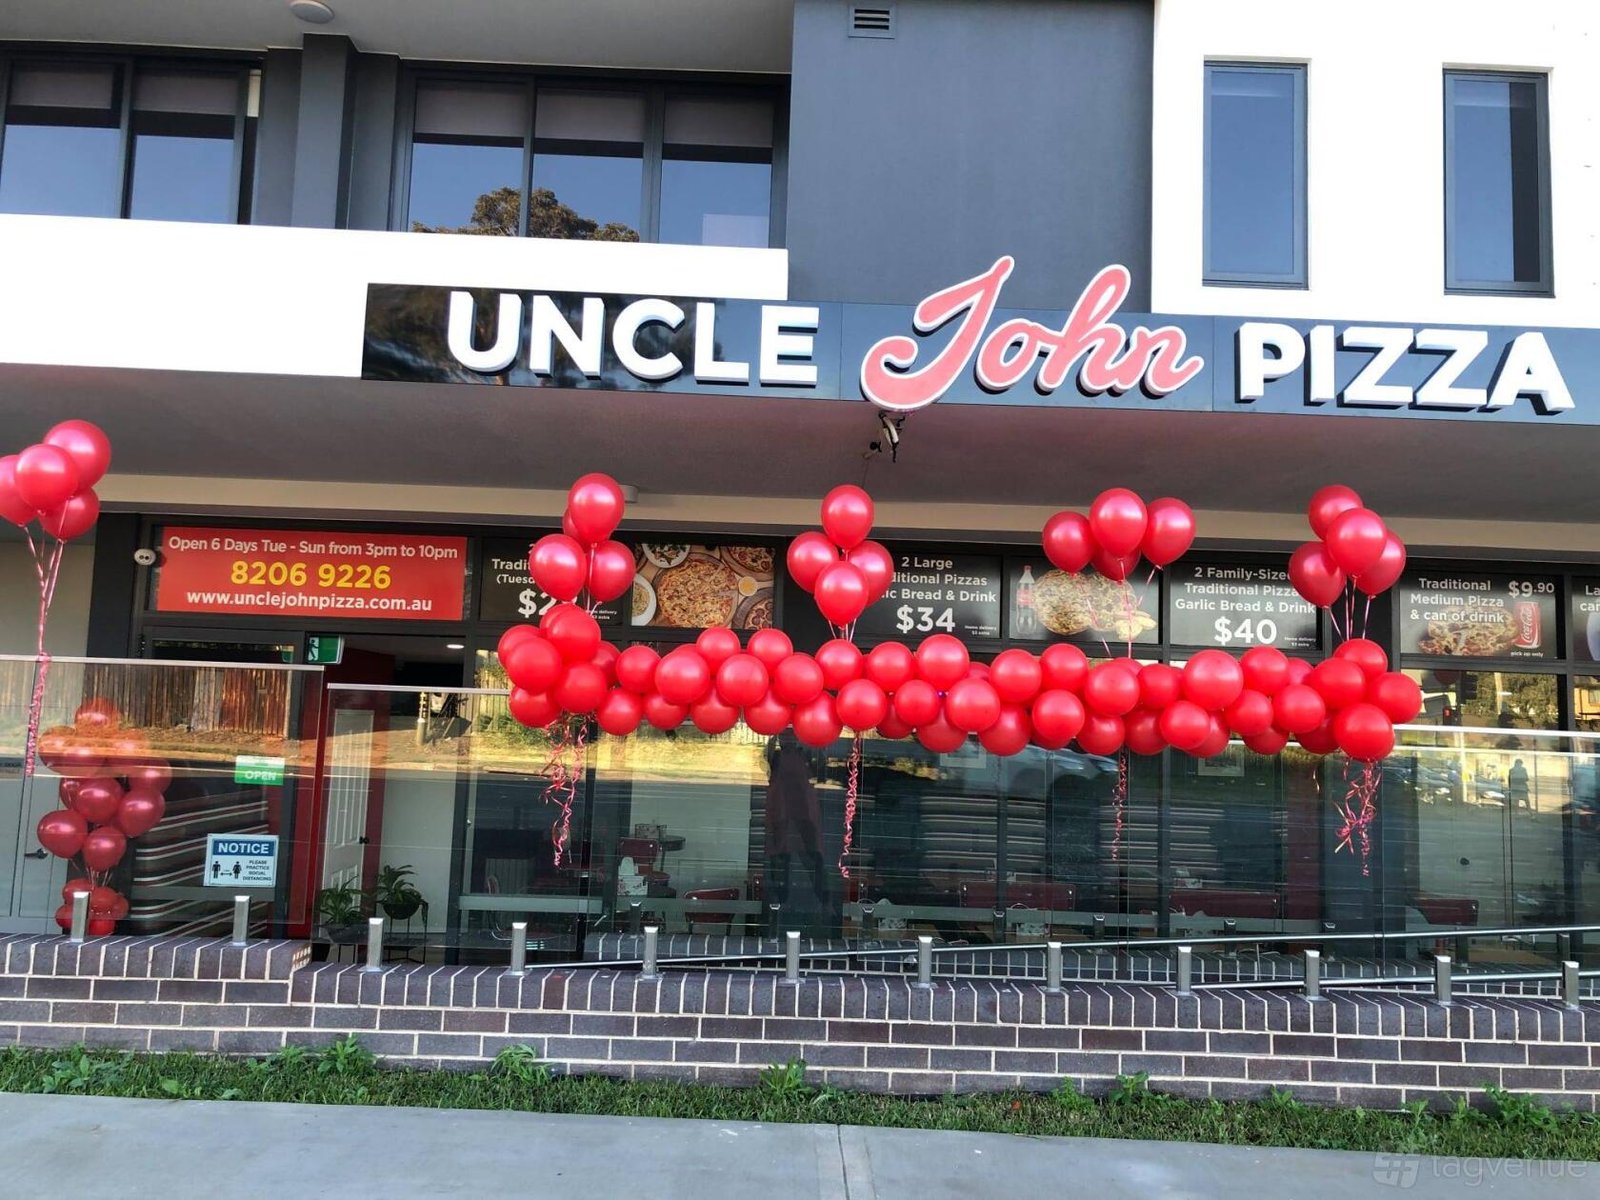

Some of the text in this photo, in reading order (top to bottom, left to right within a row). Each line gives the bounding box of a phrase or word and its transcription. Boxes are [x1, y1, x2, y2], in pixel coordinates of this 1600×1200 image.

[447, 255, 1576, 415] UNCLE John PIZZA
[168, 536, 207, 551] Open
[211, 538, 221, 550] 6
[224, 538, 258, 553] Days
[261, 539, 287, 552] Tue
[299, 541, 325, 554] Sun
[328, 541, 362, 555] from
[365, 543, 397, 558] 3pm
[400, 545, 416, 557] to
[418, 545, 458, 560] 10pm
[901, 556, 953, 570] 2 Large
[230, 560, 391, 589] 8206 9226
[944, 574, 988, 586] Pizzas
[1194, 567, 1291, 581] 2 Family-Size
[1184, 582, 1300, 597] Traditional Pizza
[1418, 577, 1491, 591] Traditional
[1508, 580, 1555, 598] $9.90
[187, 591, 432, 611] www.unclejohnpizza.com.au
[901, 588, 941, 600] Bread
[945, 590, 956, 601] &
[959, 591, 997, 602] Drink
[1410, 593, 1505, 608] Medium Pizza
[518, 588, 577, 618] $2
[1175, 598, 1316, 614] Garlic Bread & Drink
[896, 604, 956, 634] $34
[1410, 609, 1505, 623] & can of drink
[1213, 616, 1277, 646] $40
[244, 770, 277, 781] OPEN
[218, 842, 270, 854] NOTICE
